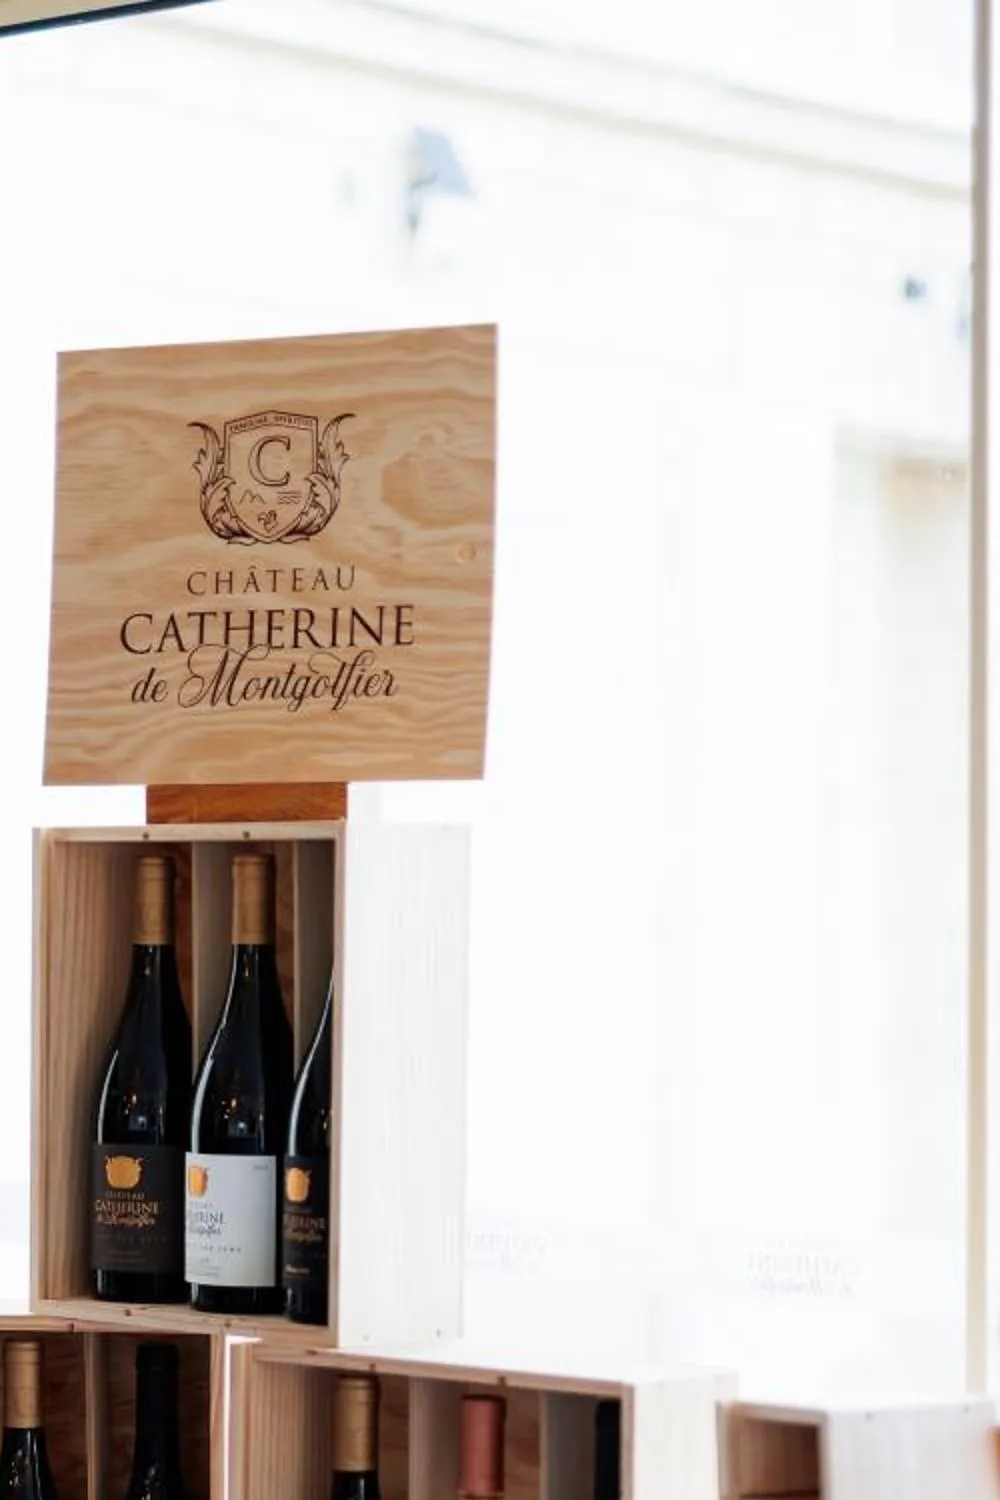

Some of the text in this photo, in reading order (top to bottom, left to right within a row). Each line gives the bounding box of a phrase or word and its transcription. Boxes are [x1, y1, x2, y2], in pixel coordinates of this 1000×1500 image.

[247, 435, 291, 487] C
[186, 564, 357, 597] CHÂTEAU
[119, 603, 415, 656] CATHERINE
[131, 643, 400, 712] de Montgolfier
